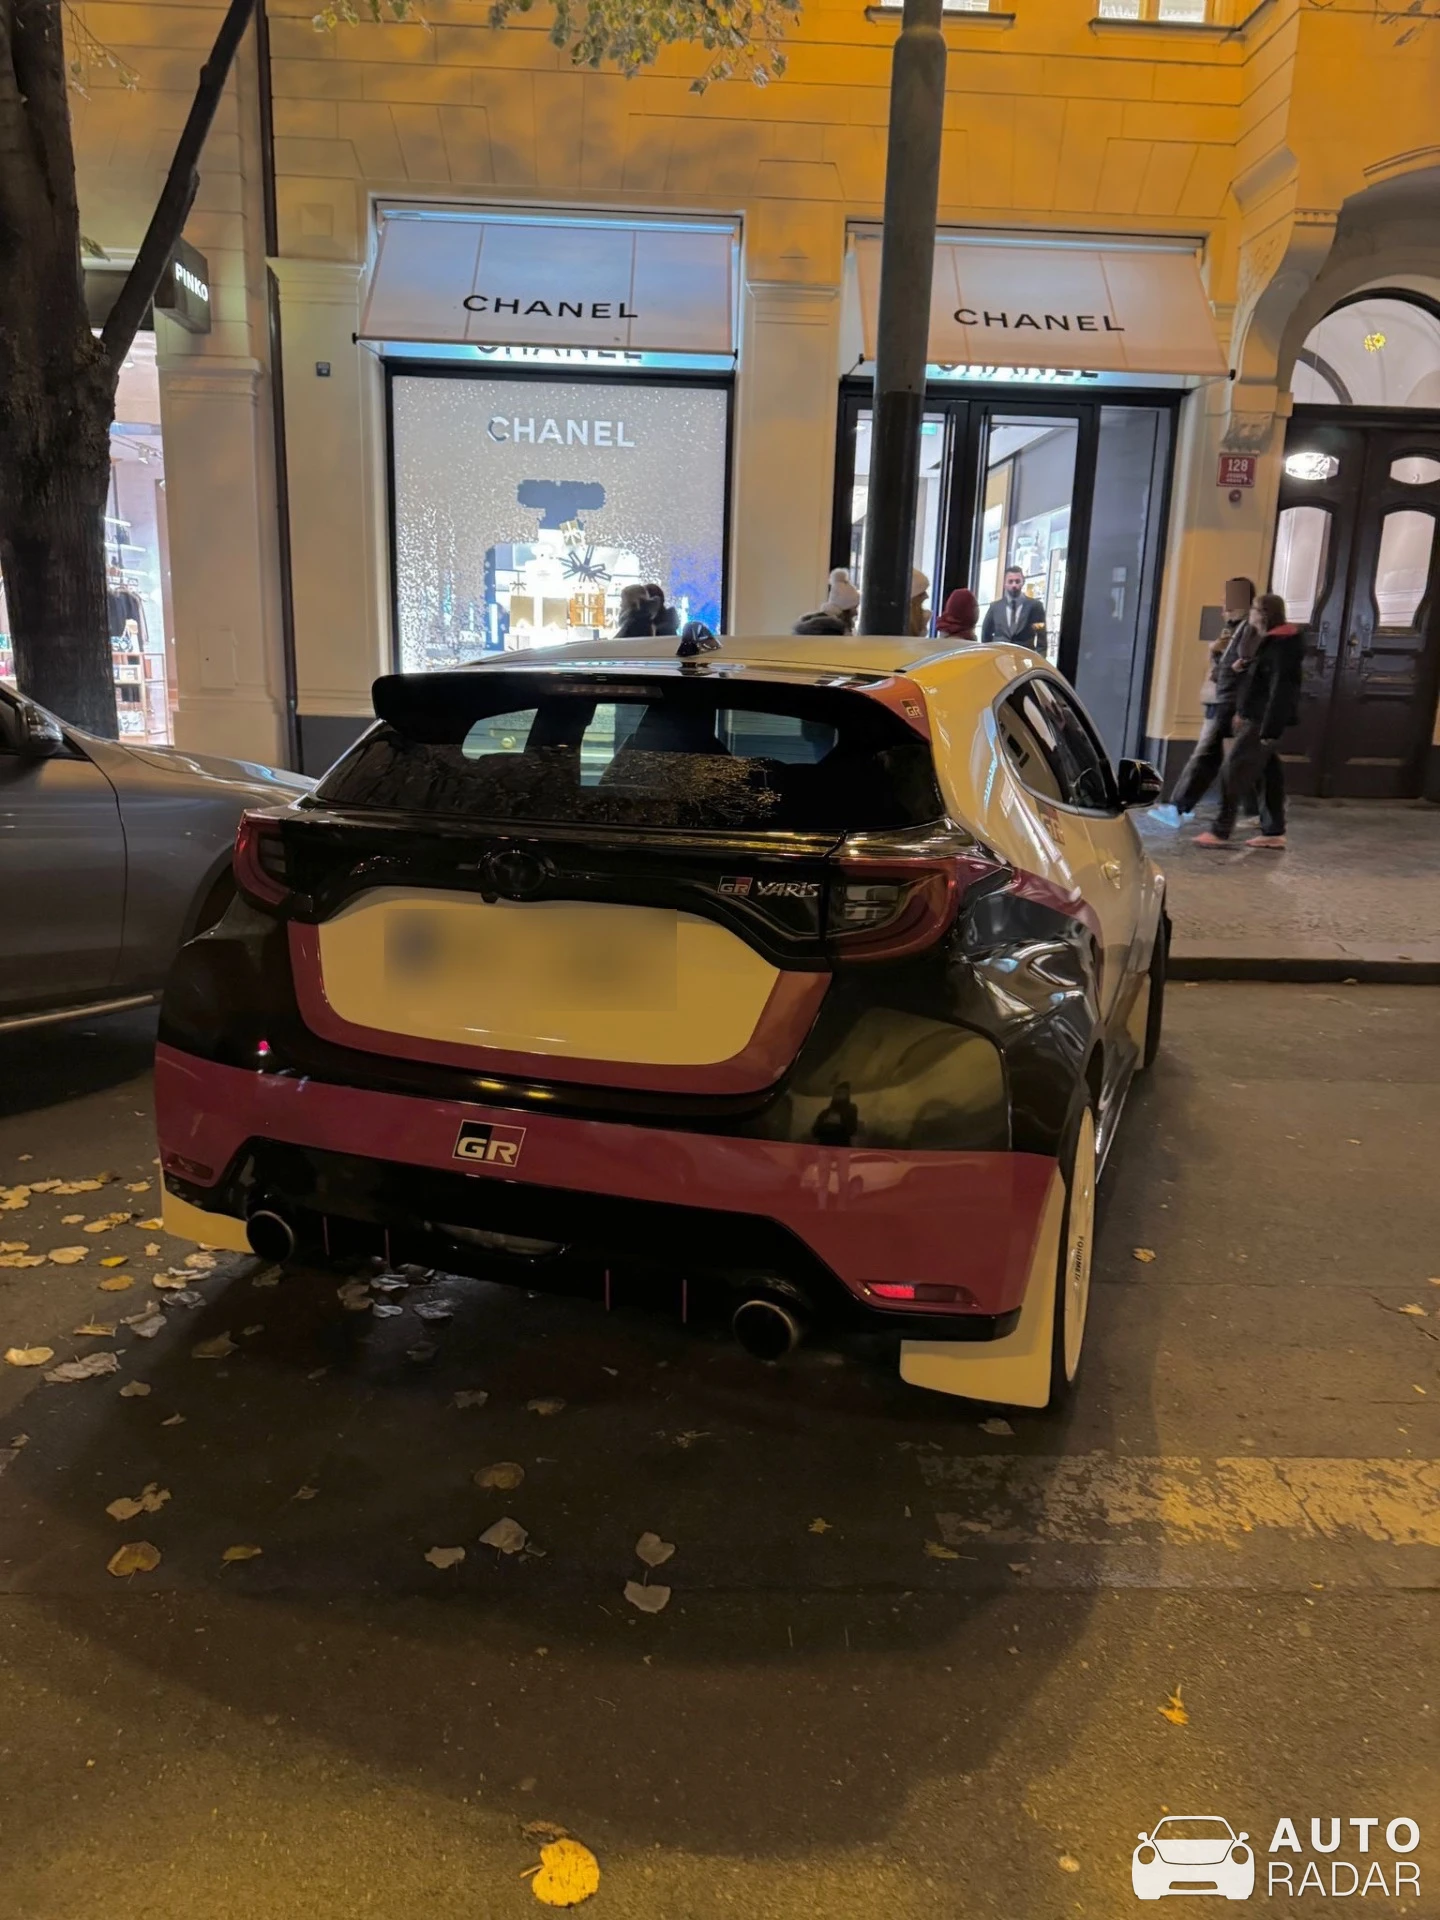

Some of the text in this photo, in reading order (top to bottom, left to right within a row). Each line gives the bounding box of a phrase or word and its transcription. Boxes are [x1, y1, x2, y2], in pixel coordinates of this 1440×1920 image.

[175, 262, 209, 302] PINKO
[463, 295, 638, 319] CHANEL
[953, 308, 1125, 332] CHANEL
[486, 416, 637, 448] CHANEL
[1228, 459, 1249, 472] 128
[757, 881, 820, 898] YARIS
[457, 1136, 518, 1164] GR
